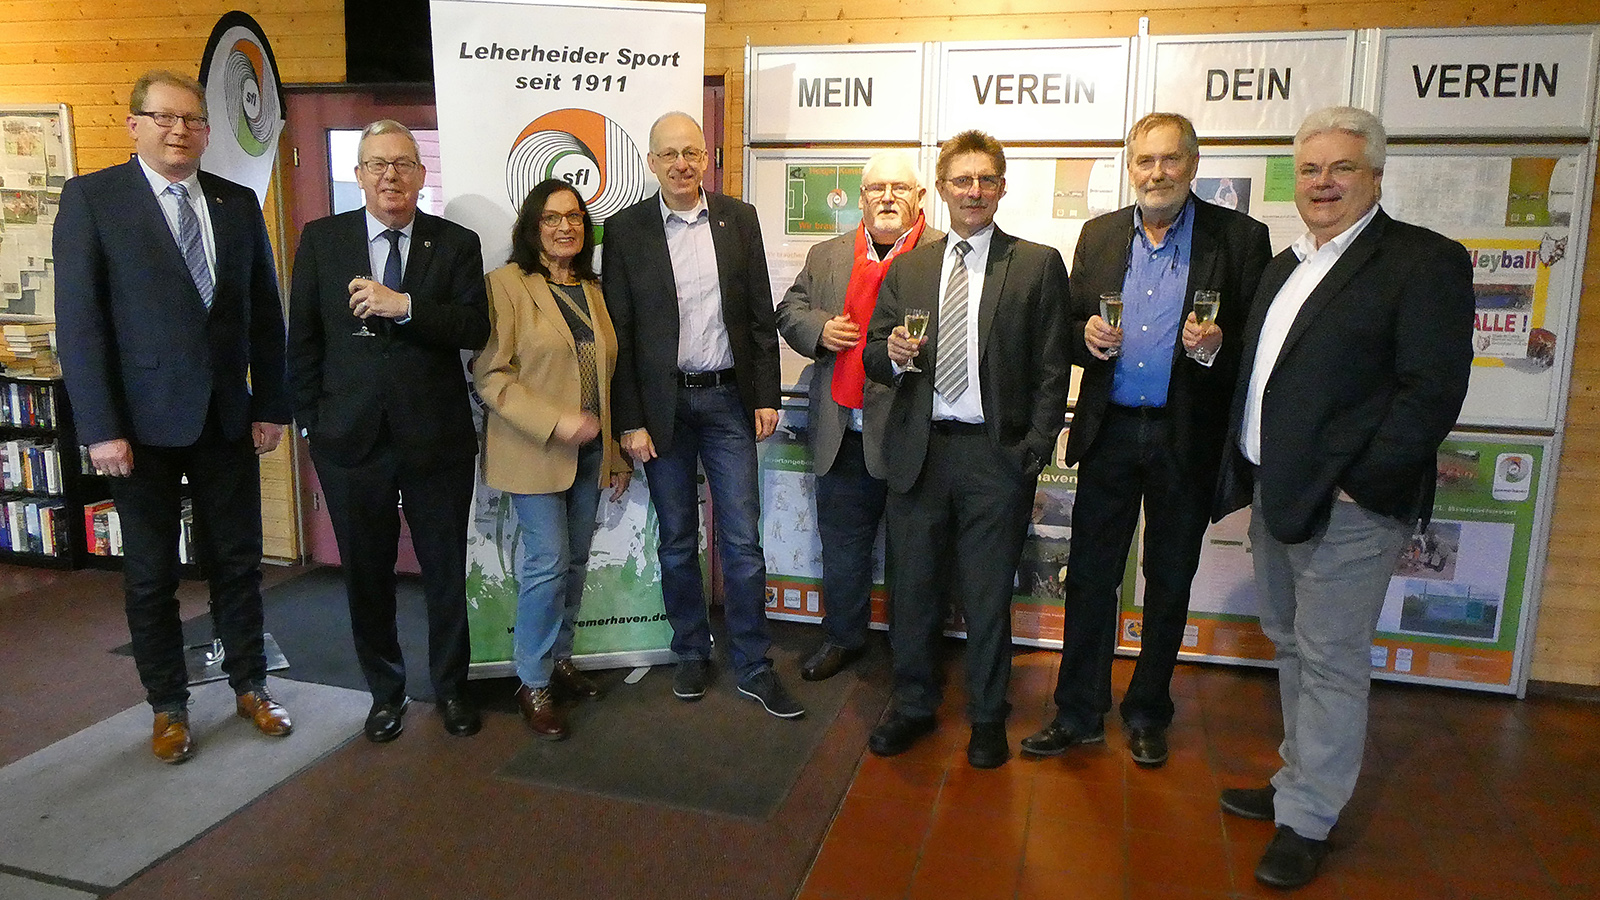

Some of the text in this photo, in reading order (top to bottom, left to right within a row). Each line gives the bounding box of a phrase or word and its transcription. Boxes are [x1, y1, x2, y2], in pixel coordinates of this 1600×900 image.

[459, 42, 680, 70] Leherheider Sport
[515, 73, 627, 92] seit 1911
[799, 77, 873, 107] MEIN
[972, 73, 1095, 105] VEREIN
[1206, 67, 1291, 101] DEIN
[1412, 63, 1559, 98] VEREIN
[562, 169, 590, 186] sfl
[1469, 250, 1537, 273] leyball
[574, 613, 668, 629] remerhaven.de
